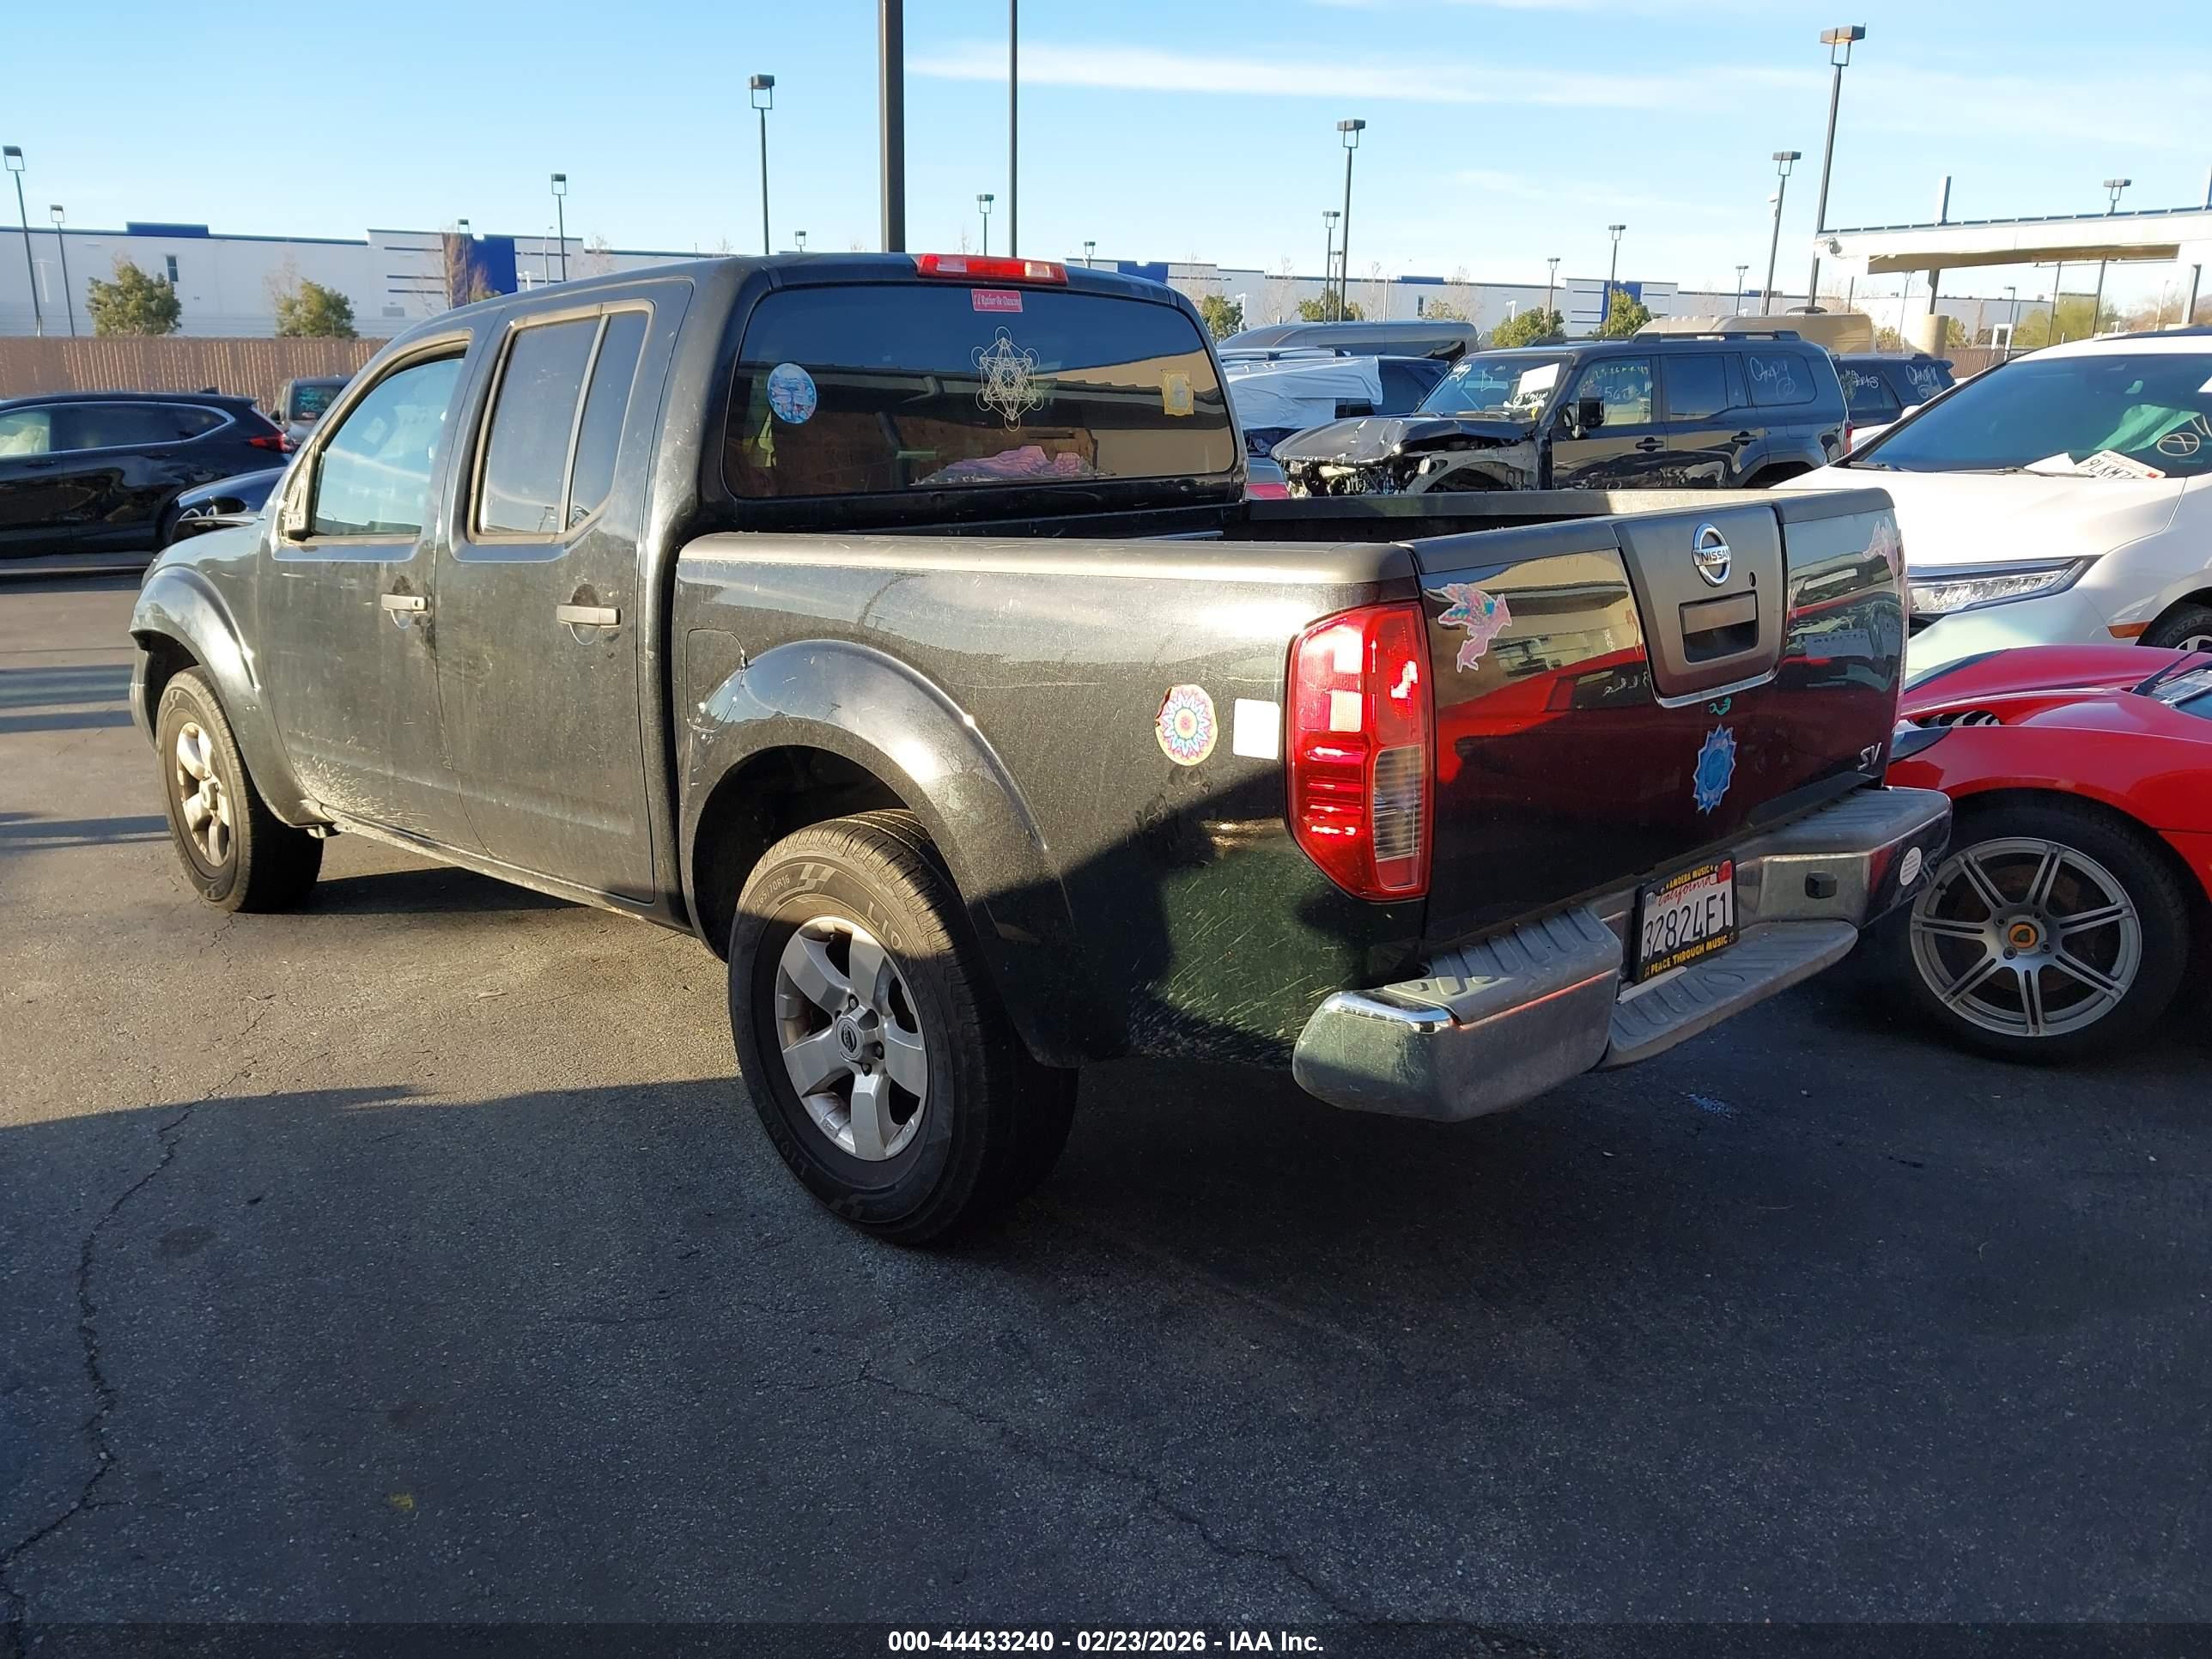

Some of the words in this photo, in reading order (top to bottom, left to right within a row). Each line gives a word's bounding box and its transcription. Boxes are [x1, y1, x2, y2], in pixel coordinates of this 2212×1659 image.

[1700, 550, 1731, 562] NISSAN
[1856, 741, 1883, 772] SV
[1692, 866, 1710, 879] MUSIC
[1658, 877, 1716, 907] California
[1642, 891, 1728, 961] 32824F1
[1650, 959, 1671, 974] PEACE
[1672, 945, 1705, 963] THROUGH
[1705, 935, 1728, 951] MUSIC
